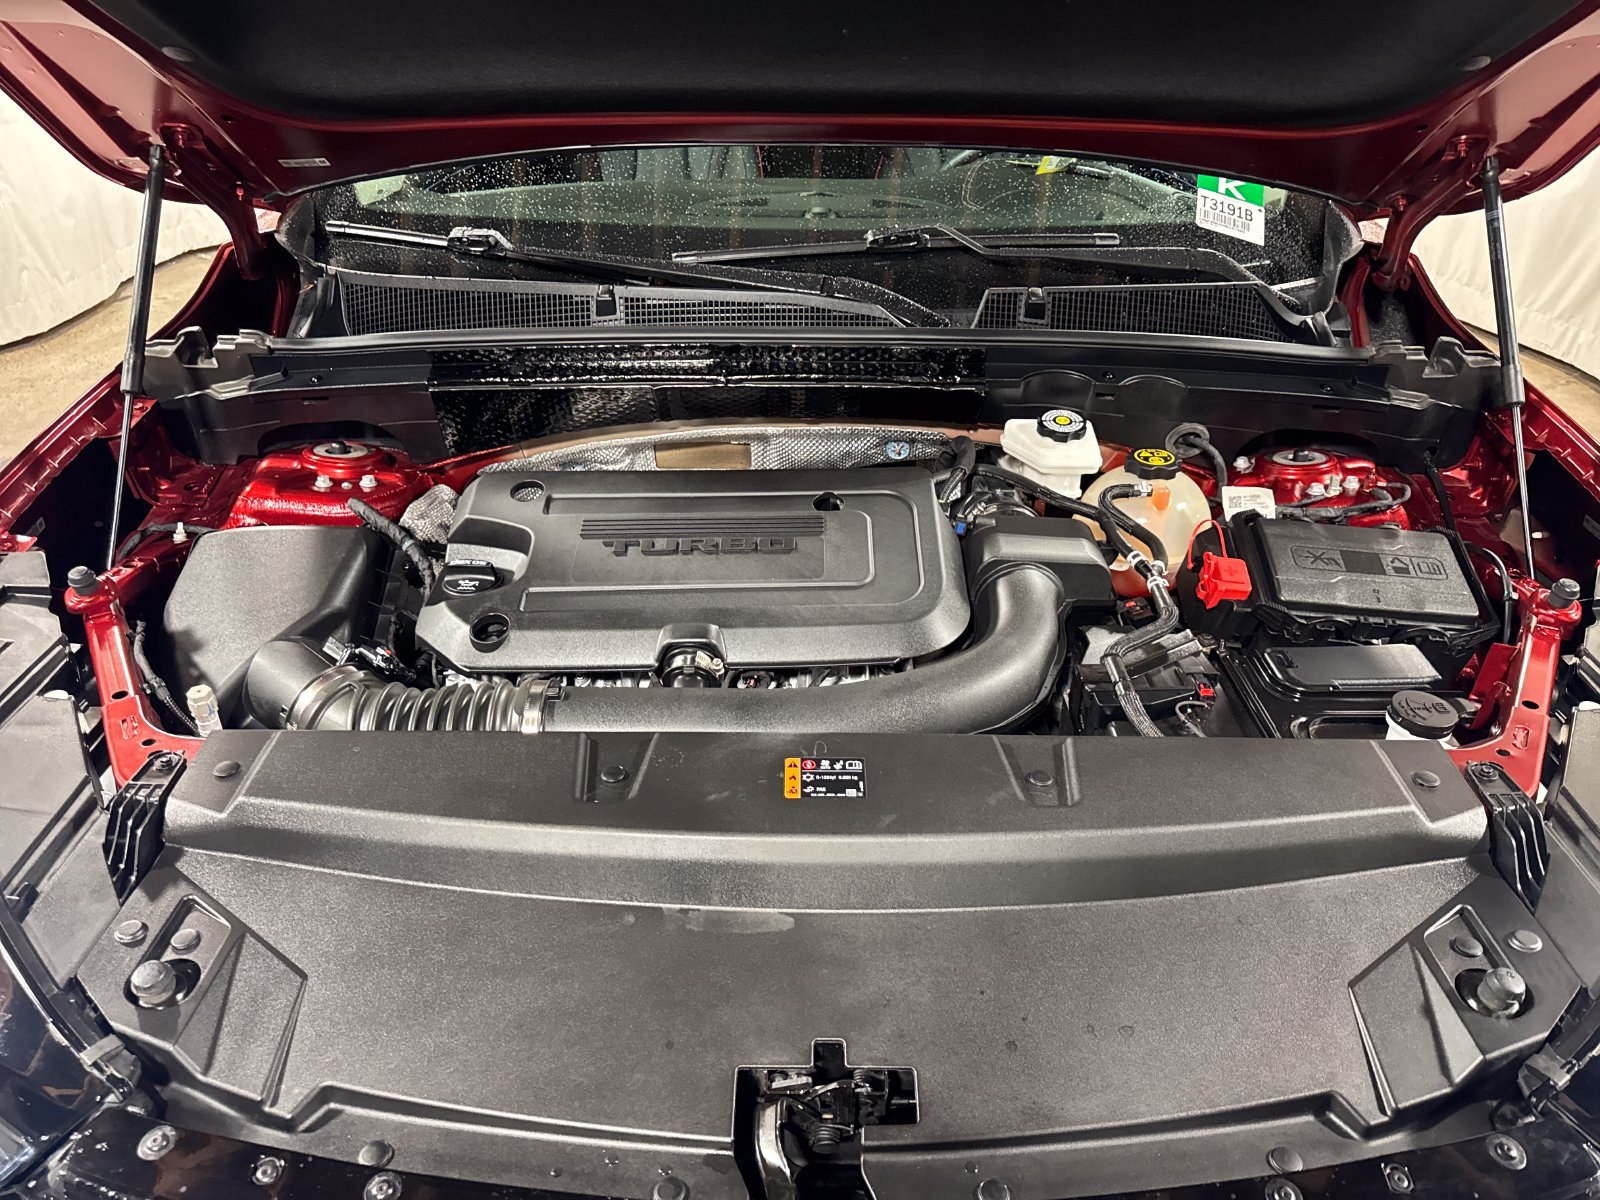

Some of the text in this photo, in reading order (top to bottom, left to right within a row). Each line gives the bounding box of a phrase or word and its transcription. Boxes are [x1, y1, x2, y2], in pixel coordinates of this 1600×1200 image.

[1218, 177, 1247, 201] K
[1201, 195, 1253, 222] T3191B
[602, 537, 797, 557] TURBO
